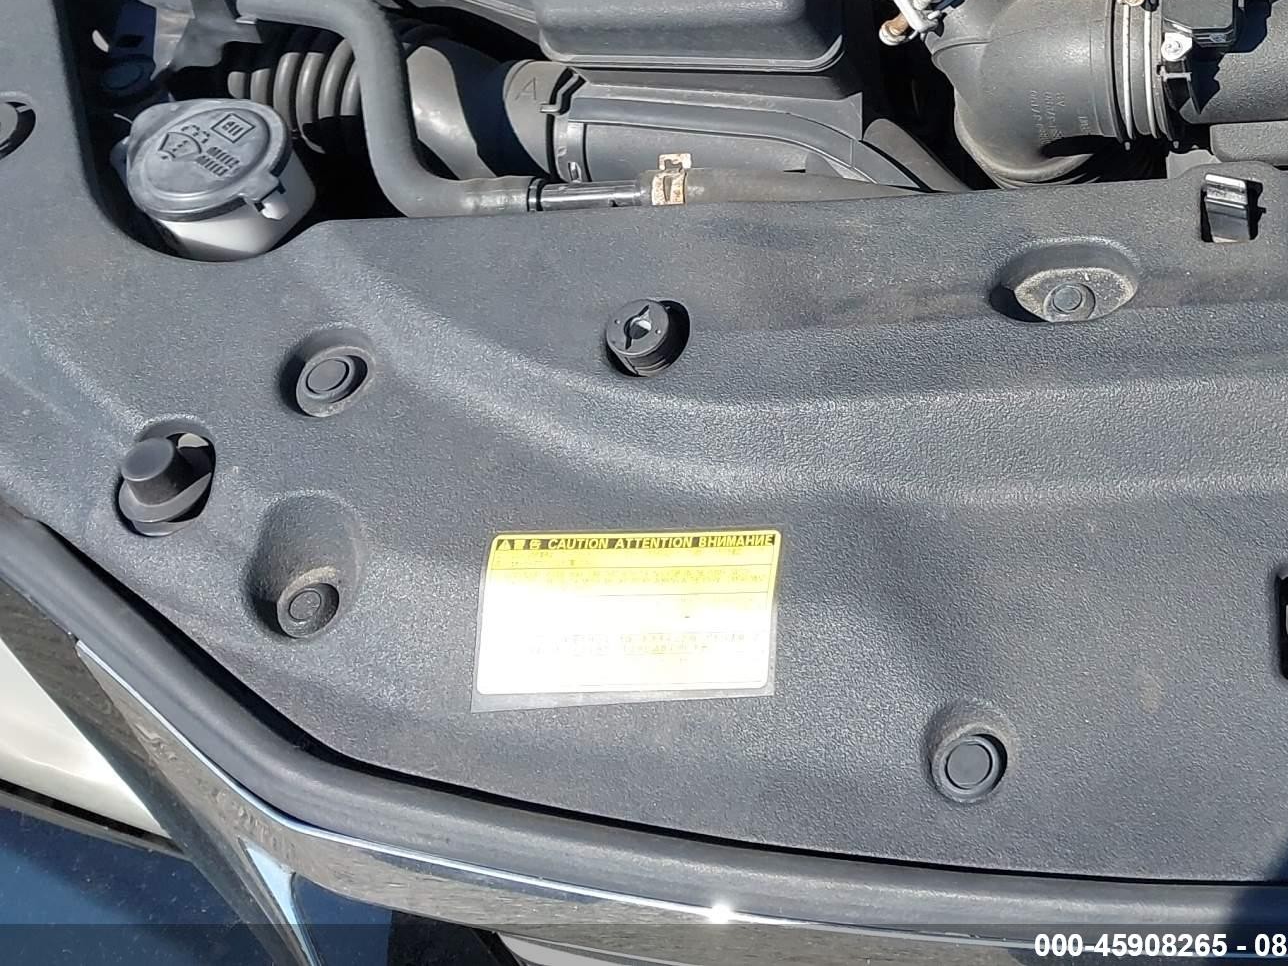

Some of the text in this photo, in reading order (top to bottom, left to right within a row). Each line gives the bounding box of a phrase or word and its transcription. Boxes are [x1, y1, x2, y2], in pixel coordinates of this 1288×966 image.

[547, 538, 609, 550] CAUTION
[614, 536, 693, 549] ATTENTION
[698, 534, 774, 548] ВНИМАНИЕ
